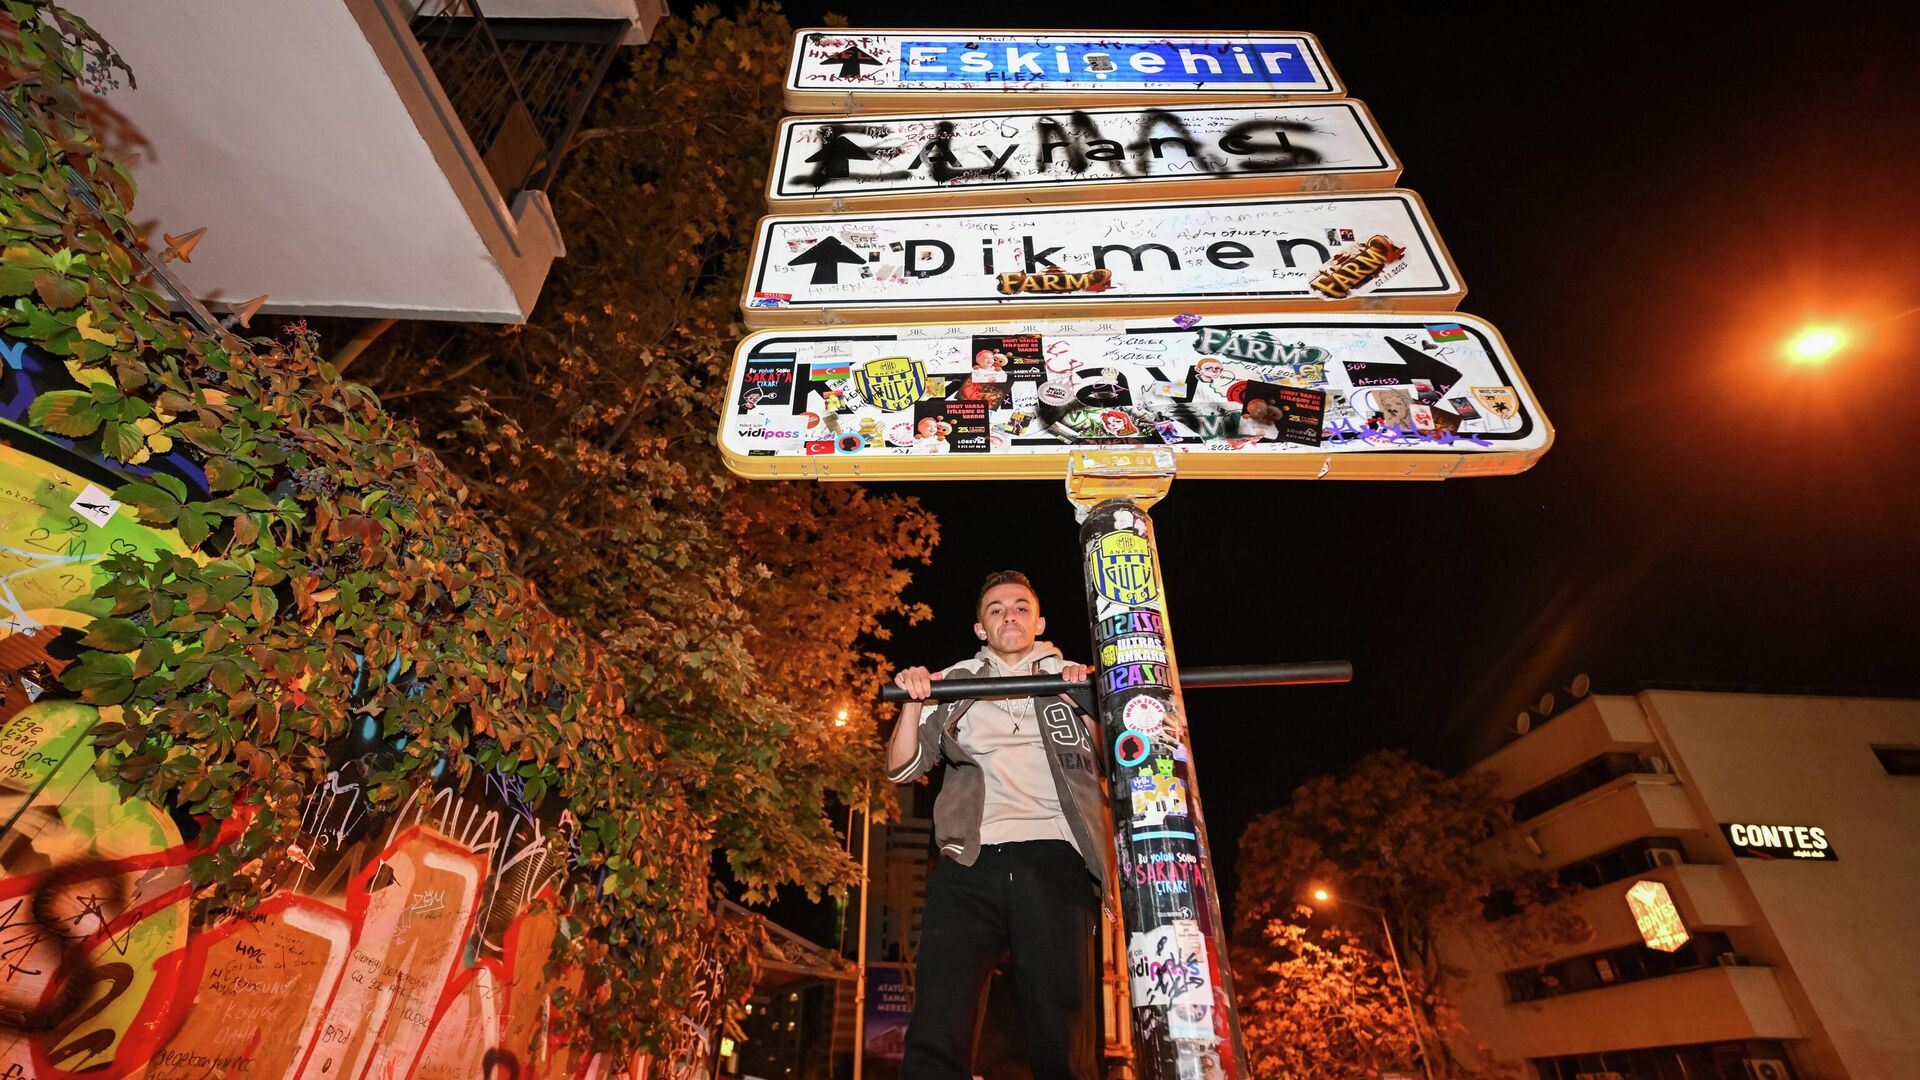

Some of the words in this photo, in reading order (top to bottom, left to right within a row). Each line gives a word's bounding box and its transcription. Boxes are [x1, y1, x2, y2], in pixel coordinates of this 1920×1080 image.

[909, 46, 1292, 80] Eskişehir
[985, 71, 1045, 81] FLEX
[904, 235, 1331, 278] Dikmen
[1001, 273, 1090, 292] FARM
[1310, 247, 1388, 298] FARM
[1198, 327, 1304, 366] FARM
[738, 427, 800, 440] vidipass
[1117, 637, 1162, 651] ULTRAS
[1117, 648, 1167, 664] ANKARA
[12, 716, 44, 735] Ege
[1730, 823, 1828, 849] CONTES
[1136, 861, 1204, 886] SARAY'A
